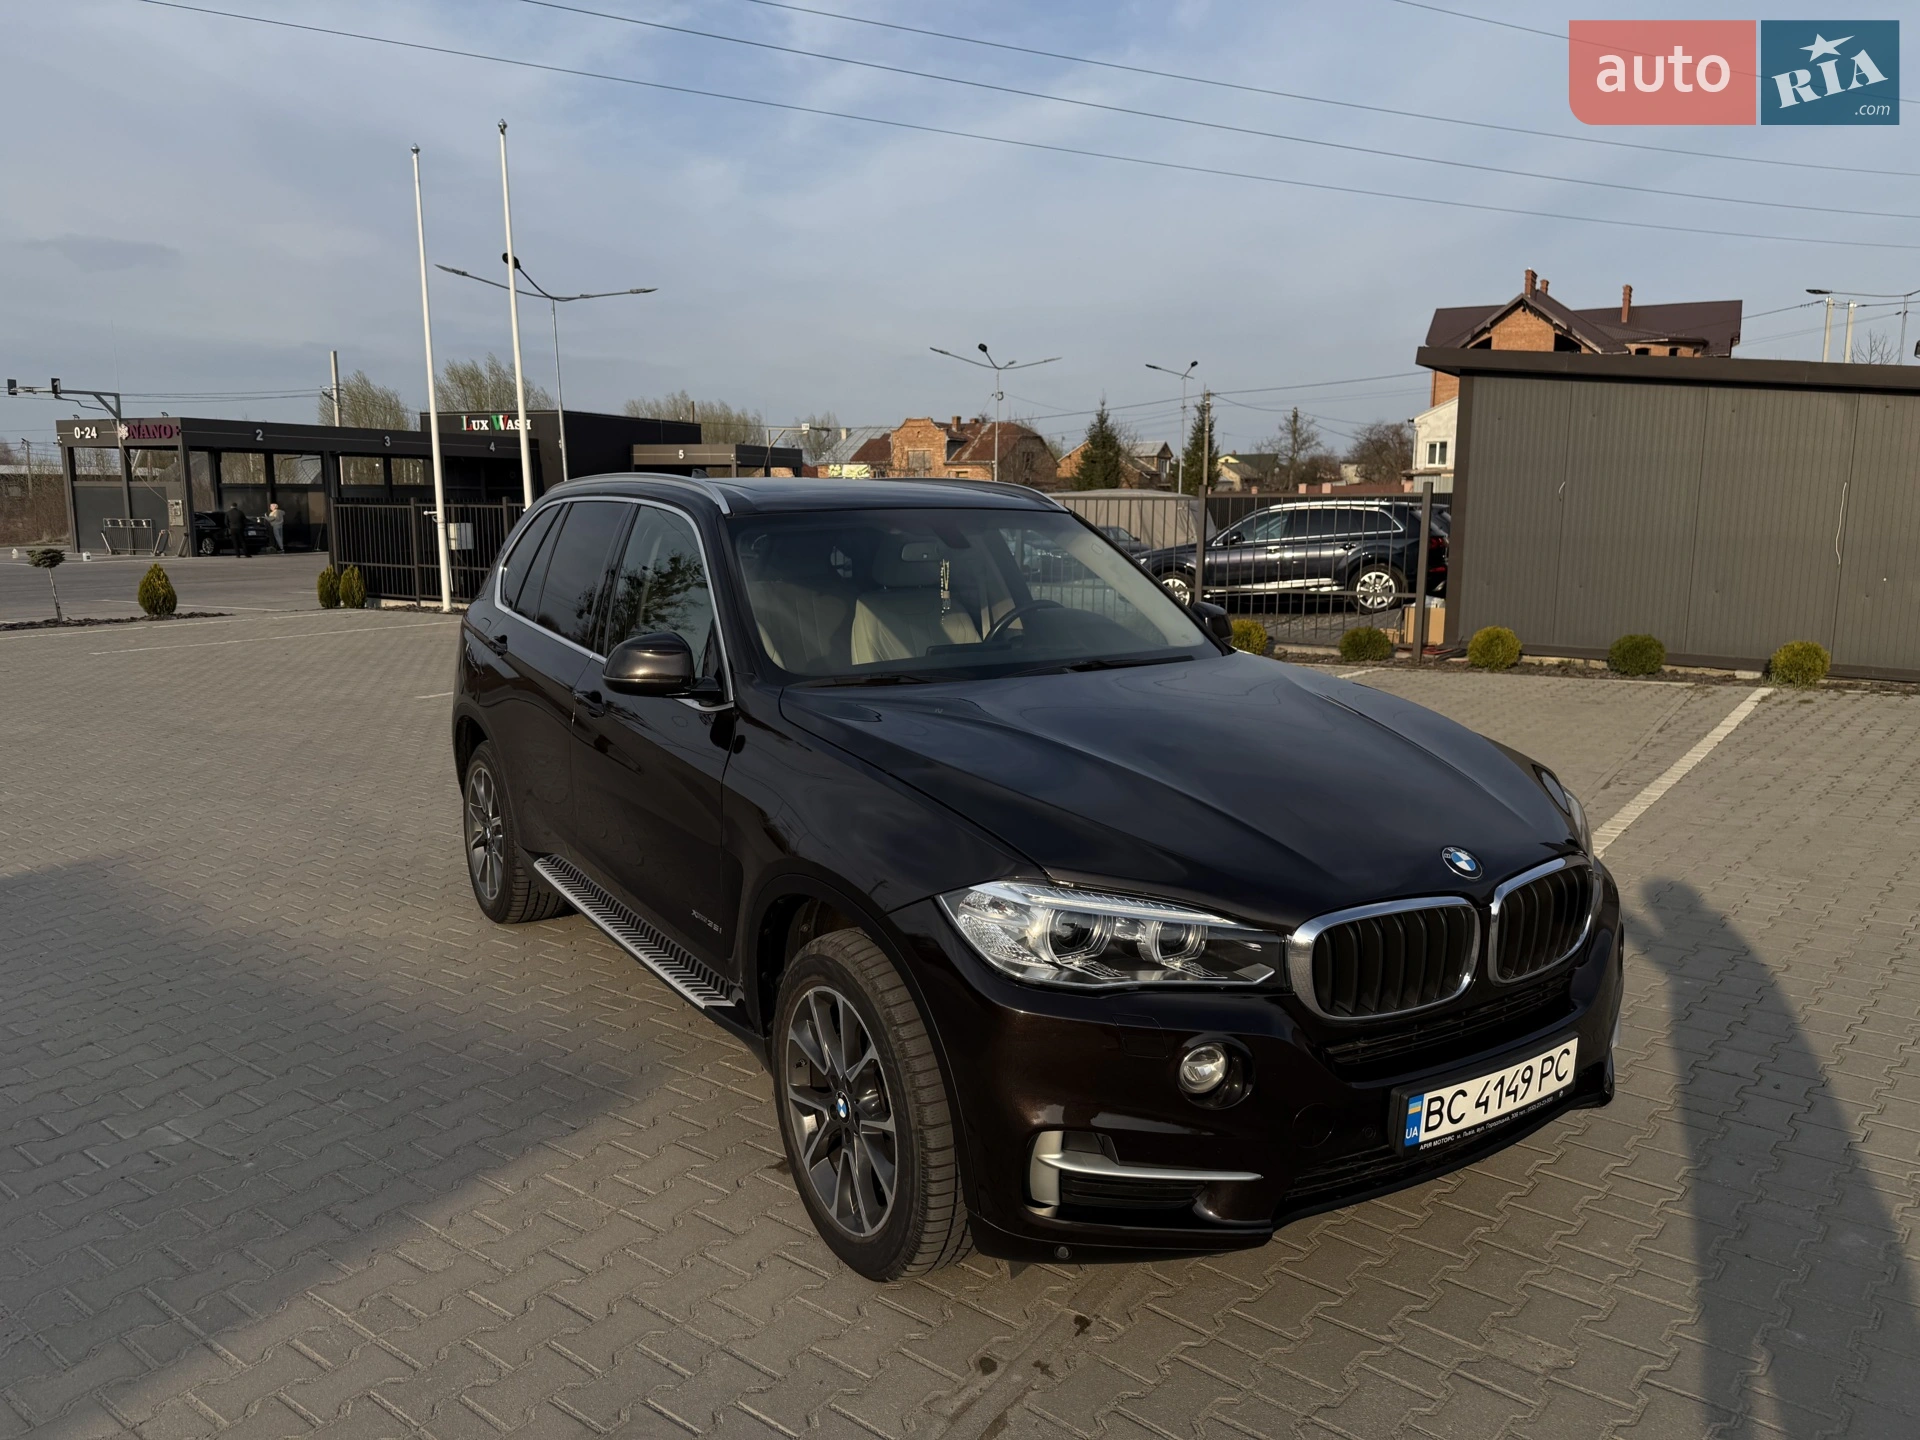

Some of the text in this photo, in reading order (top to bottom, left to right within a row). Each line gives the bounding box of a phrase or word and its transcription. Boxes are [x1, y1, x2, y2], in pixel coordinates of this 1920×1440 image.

[54, 380, 61, 393] 1
[74, 426, 98, 439] 0-24
[128, 424, 173, 439] NANO
[255, 428, 264, 441] 2
[384, 435, 391, 447] 3
[489, 441, 496, 452] 4
[678, 449, 685, 460] 5
[1424, 1048, 1571, 1133] BC 4149 PC
[1405, 1125, 1419, 1139] UA
